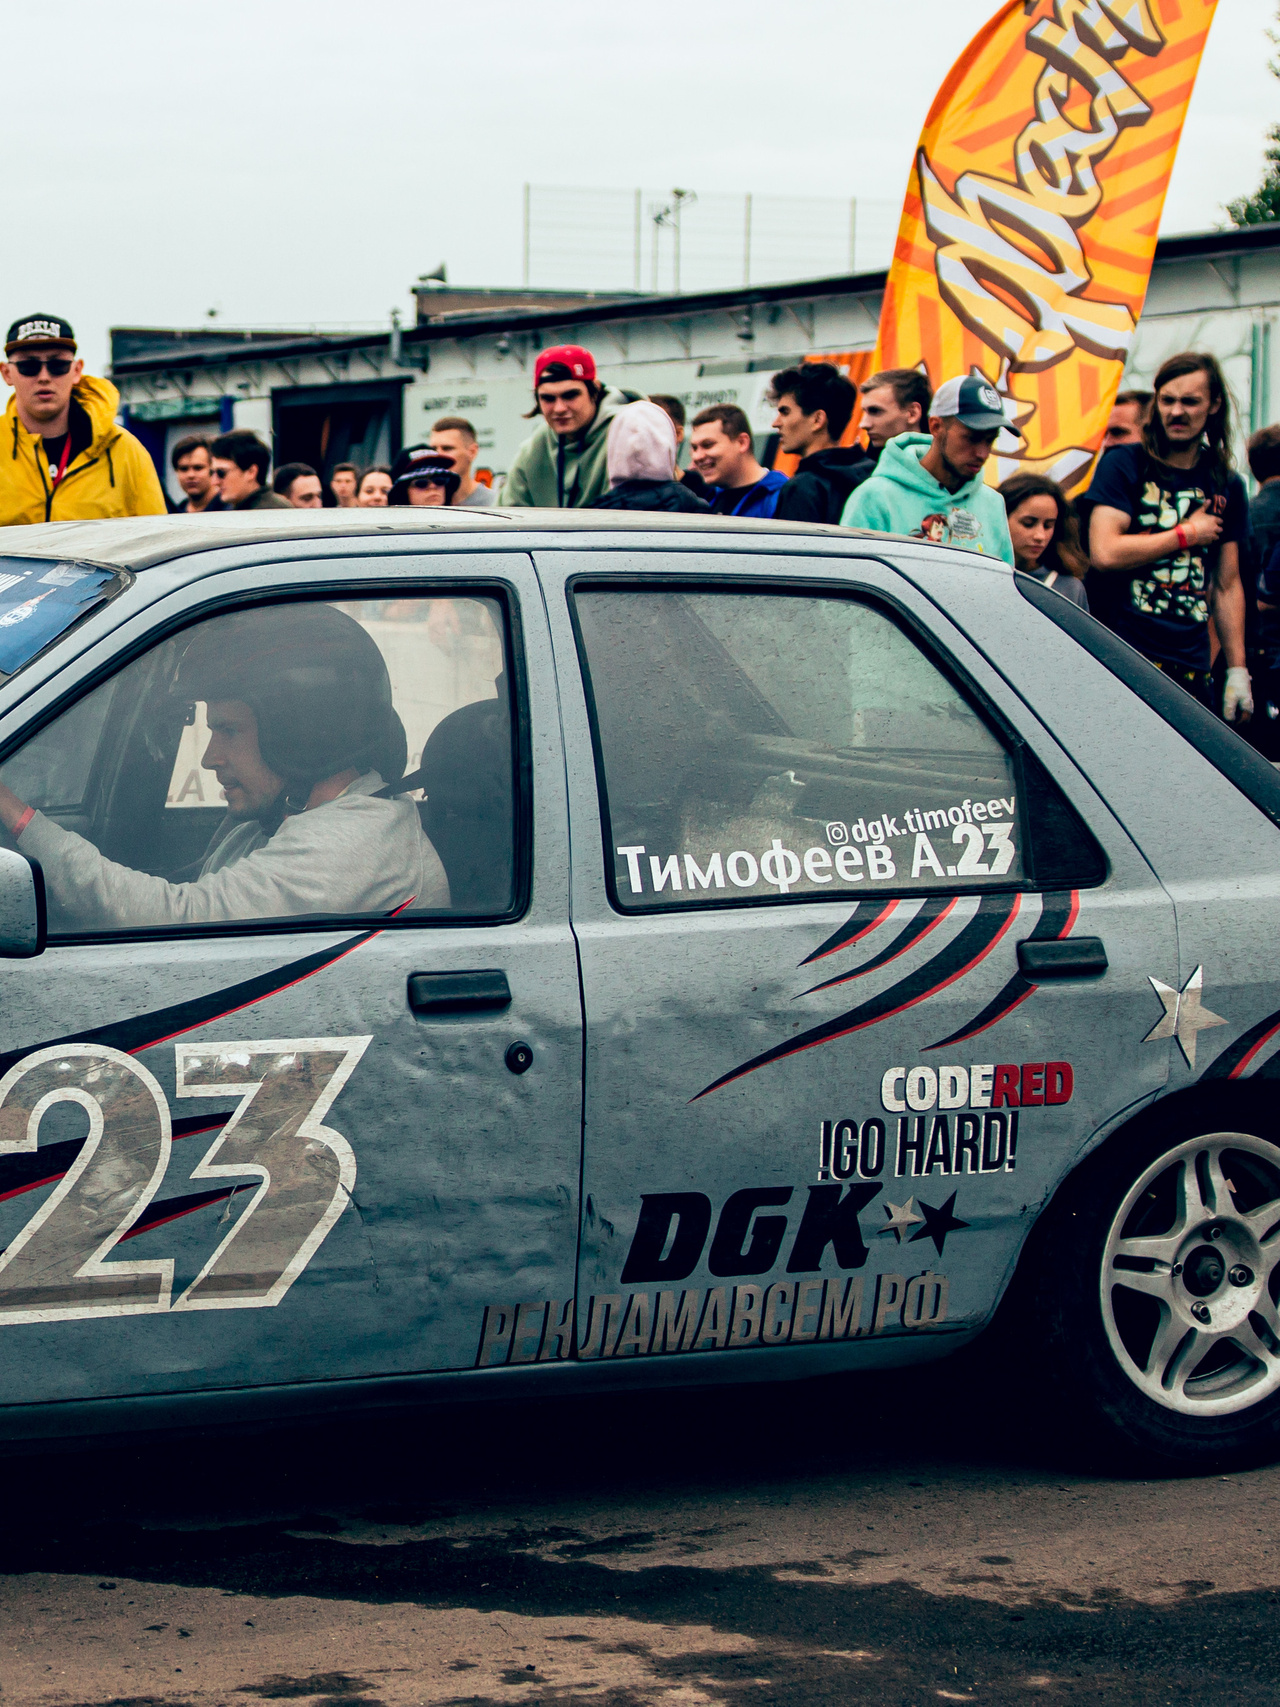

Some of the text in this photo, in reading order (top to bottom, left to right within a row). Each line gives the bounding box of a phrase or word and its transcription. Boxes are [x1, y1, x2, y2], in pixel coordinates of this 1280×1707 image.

[851, 797, 1016, 845] dgk.timofeev
[617, 838, 897, 893] Тимофеев
[893, 1110, 1019, 1178] HARD!
[621, 1181, 884, 1284] DGK
[477, 1269, 951, 1367] РЕКЛАМАВСЕМ.РФ
